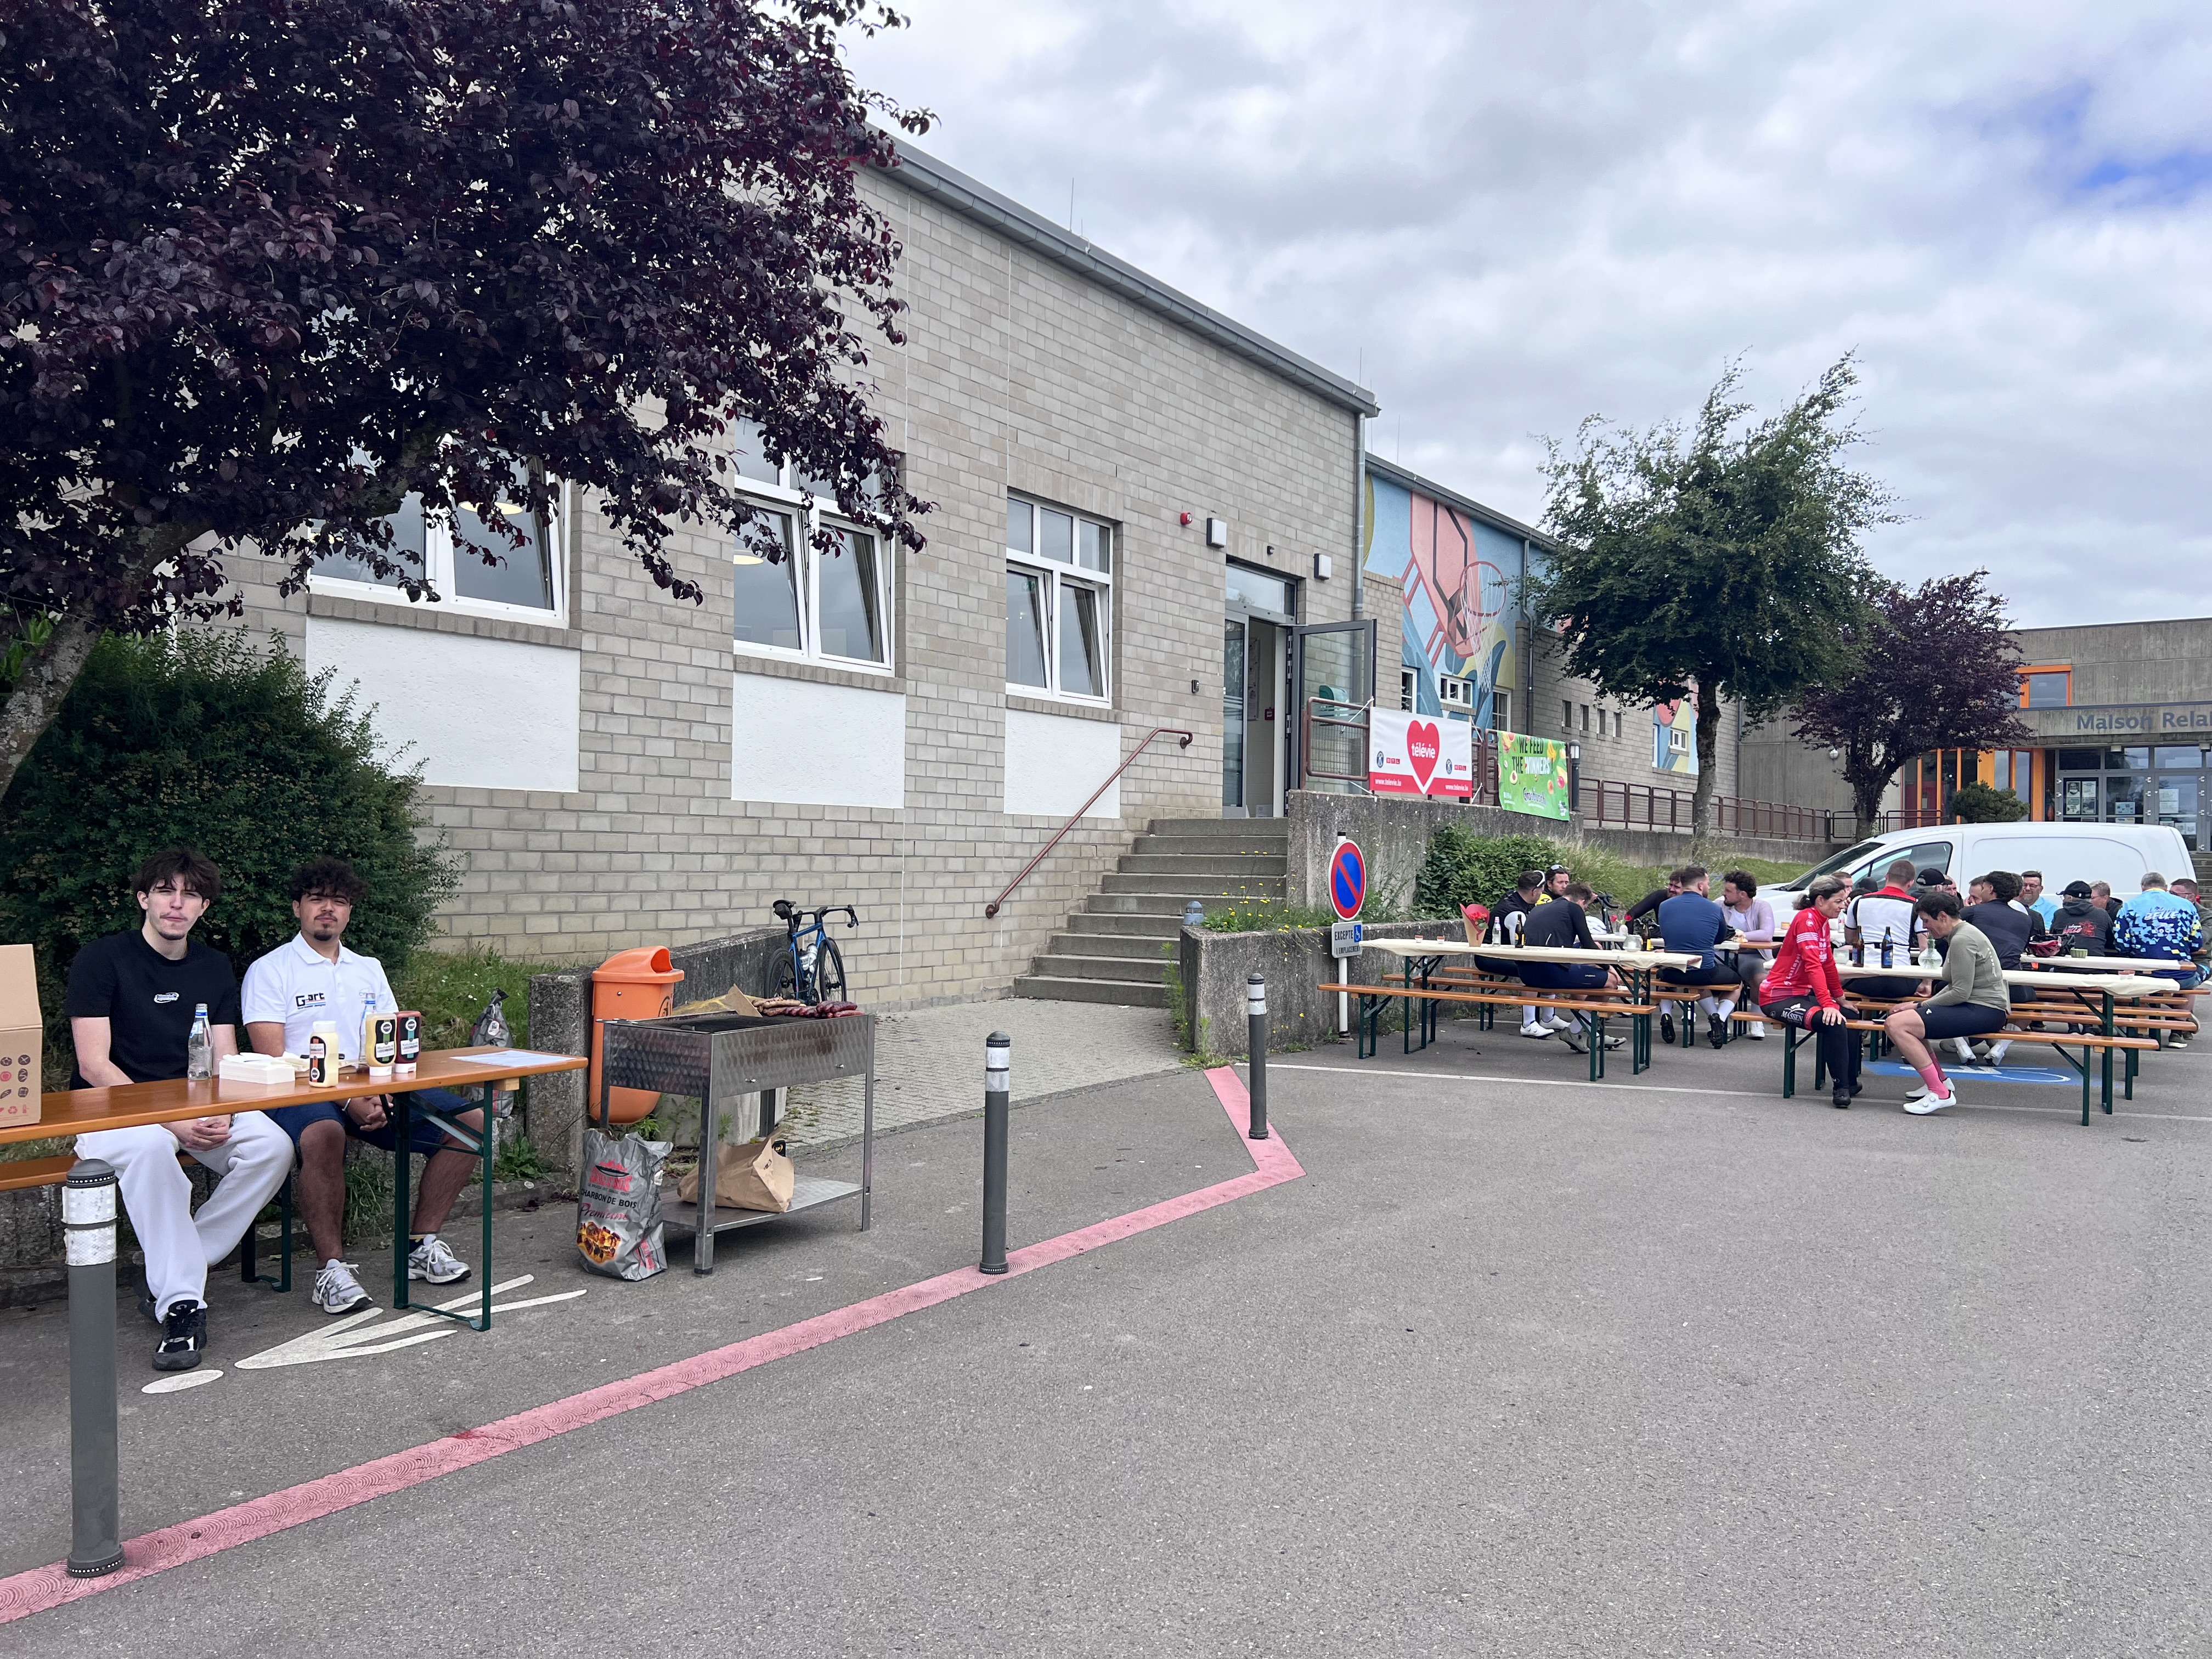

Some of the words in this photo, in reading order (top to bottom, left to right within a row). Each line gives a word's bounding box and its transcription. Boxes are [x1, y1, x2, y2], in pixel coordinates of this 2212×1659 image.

[2076, 714, 2153, 730] Maison
[1411, 742, 1435, 759] télévie
[1519, 736, 1528, 753] WE
[1530, 737, 1544, 754] FEED
[1512, 756, 1523, 774] THE
[1781, 1011, 1803, 1022] MASSEN
[581, 1188, 607, 1203] CHARBON
[607, 1197, 617, 1205] DE
[619, 1199, 638, 1209] BOIS
